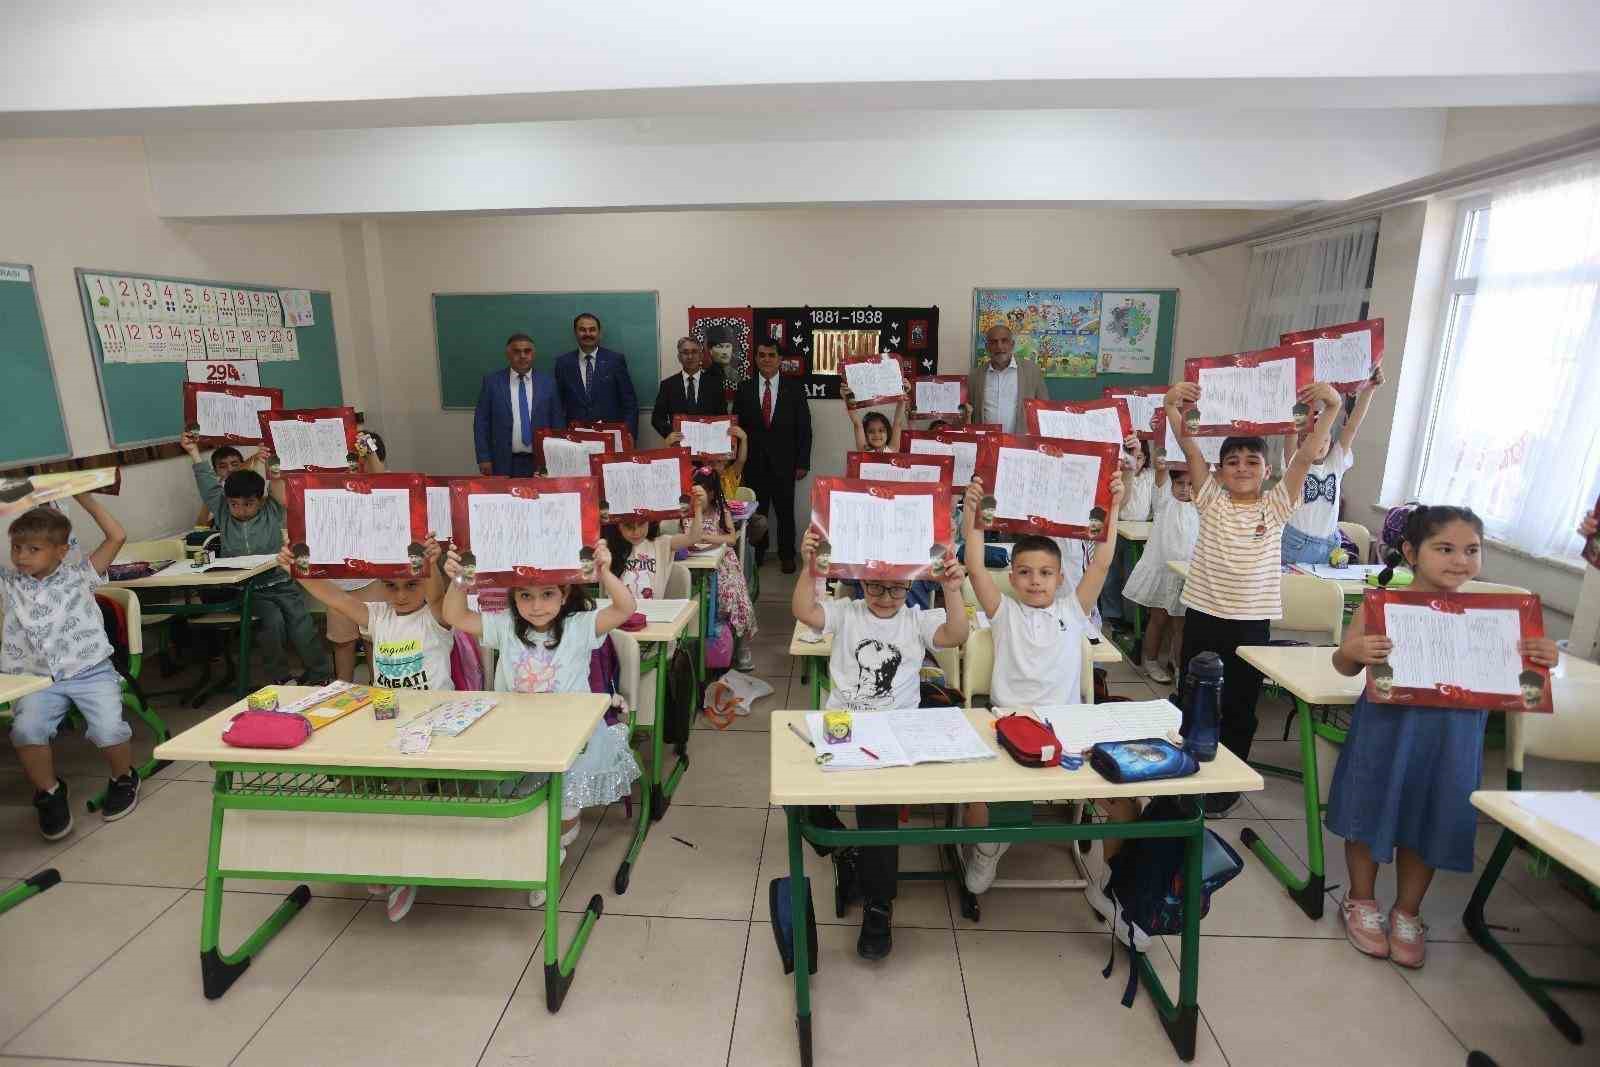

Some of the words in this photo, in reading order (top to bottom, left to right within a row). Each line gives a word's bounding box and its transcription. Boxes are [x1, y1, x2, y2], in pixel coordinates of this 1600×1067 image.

[96, 279, 104, 294] 1
[119, 280, 130, 296] 2
[142, 282, 152, 297] 3
[163, 285, 172, 299] 4
[184, 288, 194, 303] 5
[203, 288, 211, 302] 6
[219, 292, 227, 305] 7
[238, 292, 245, 305] 8
[253, 293, 260, 305] 9
[267, 295, 278, 308] 10
[104, 324, 117, 339] 11
[126, 324, 142, 339] 12
[148, 324, 163, 339] 13
[168, 326, 181, 340] 14
[188, 329, 202, 343] 15
[208, 328, 220, 342] 16
[226, 330, 237, 343] 17
[242, 330, 252, 343] 18
[257, 330, 267, 342] 19
[270, 329, 282, 343] 20
[206, 364, 227, 380] 29
